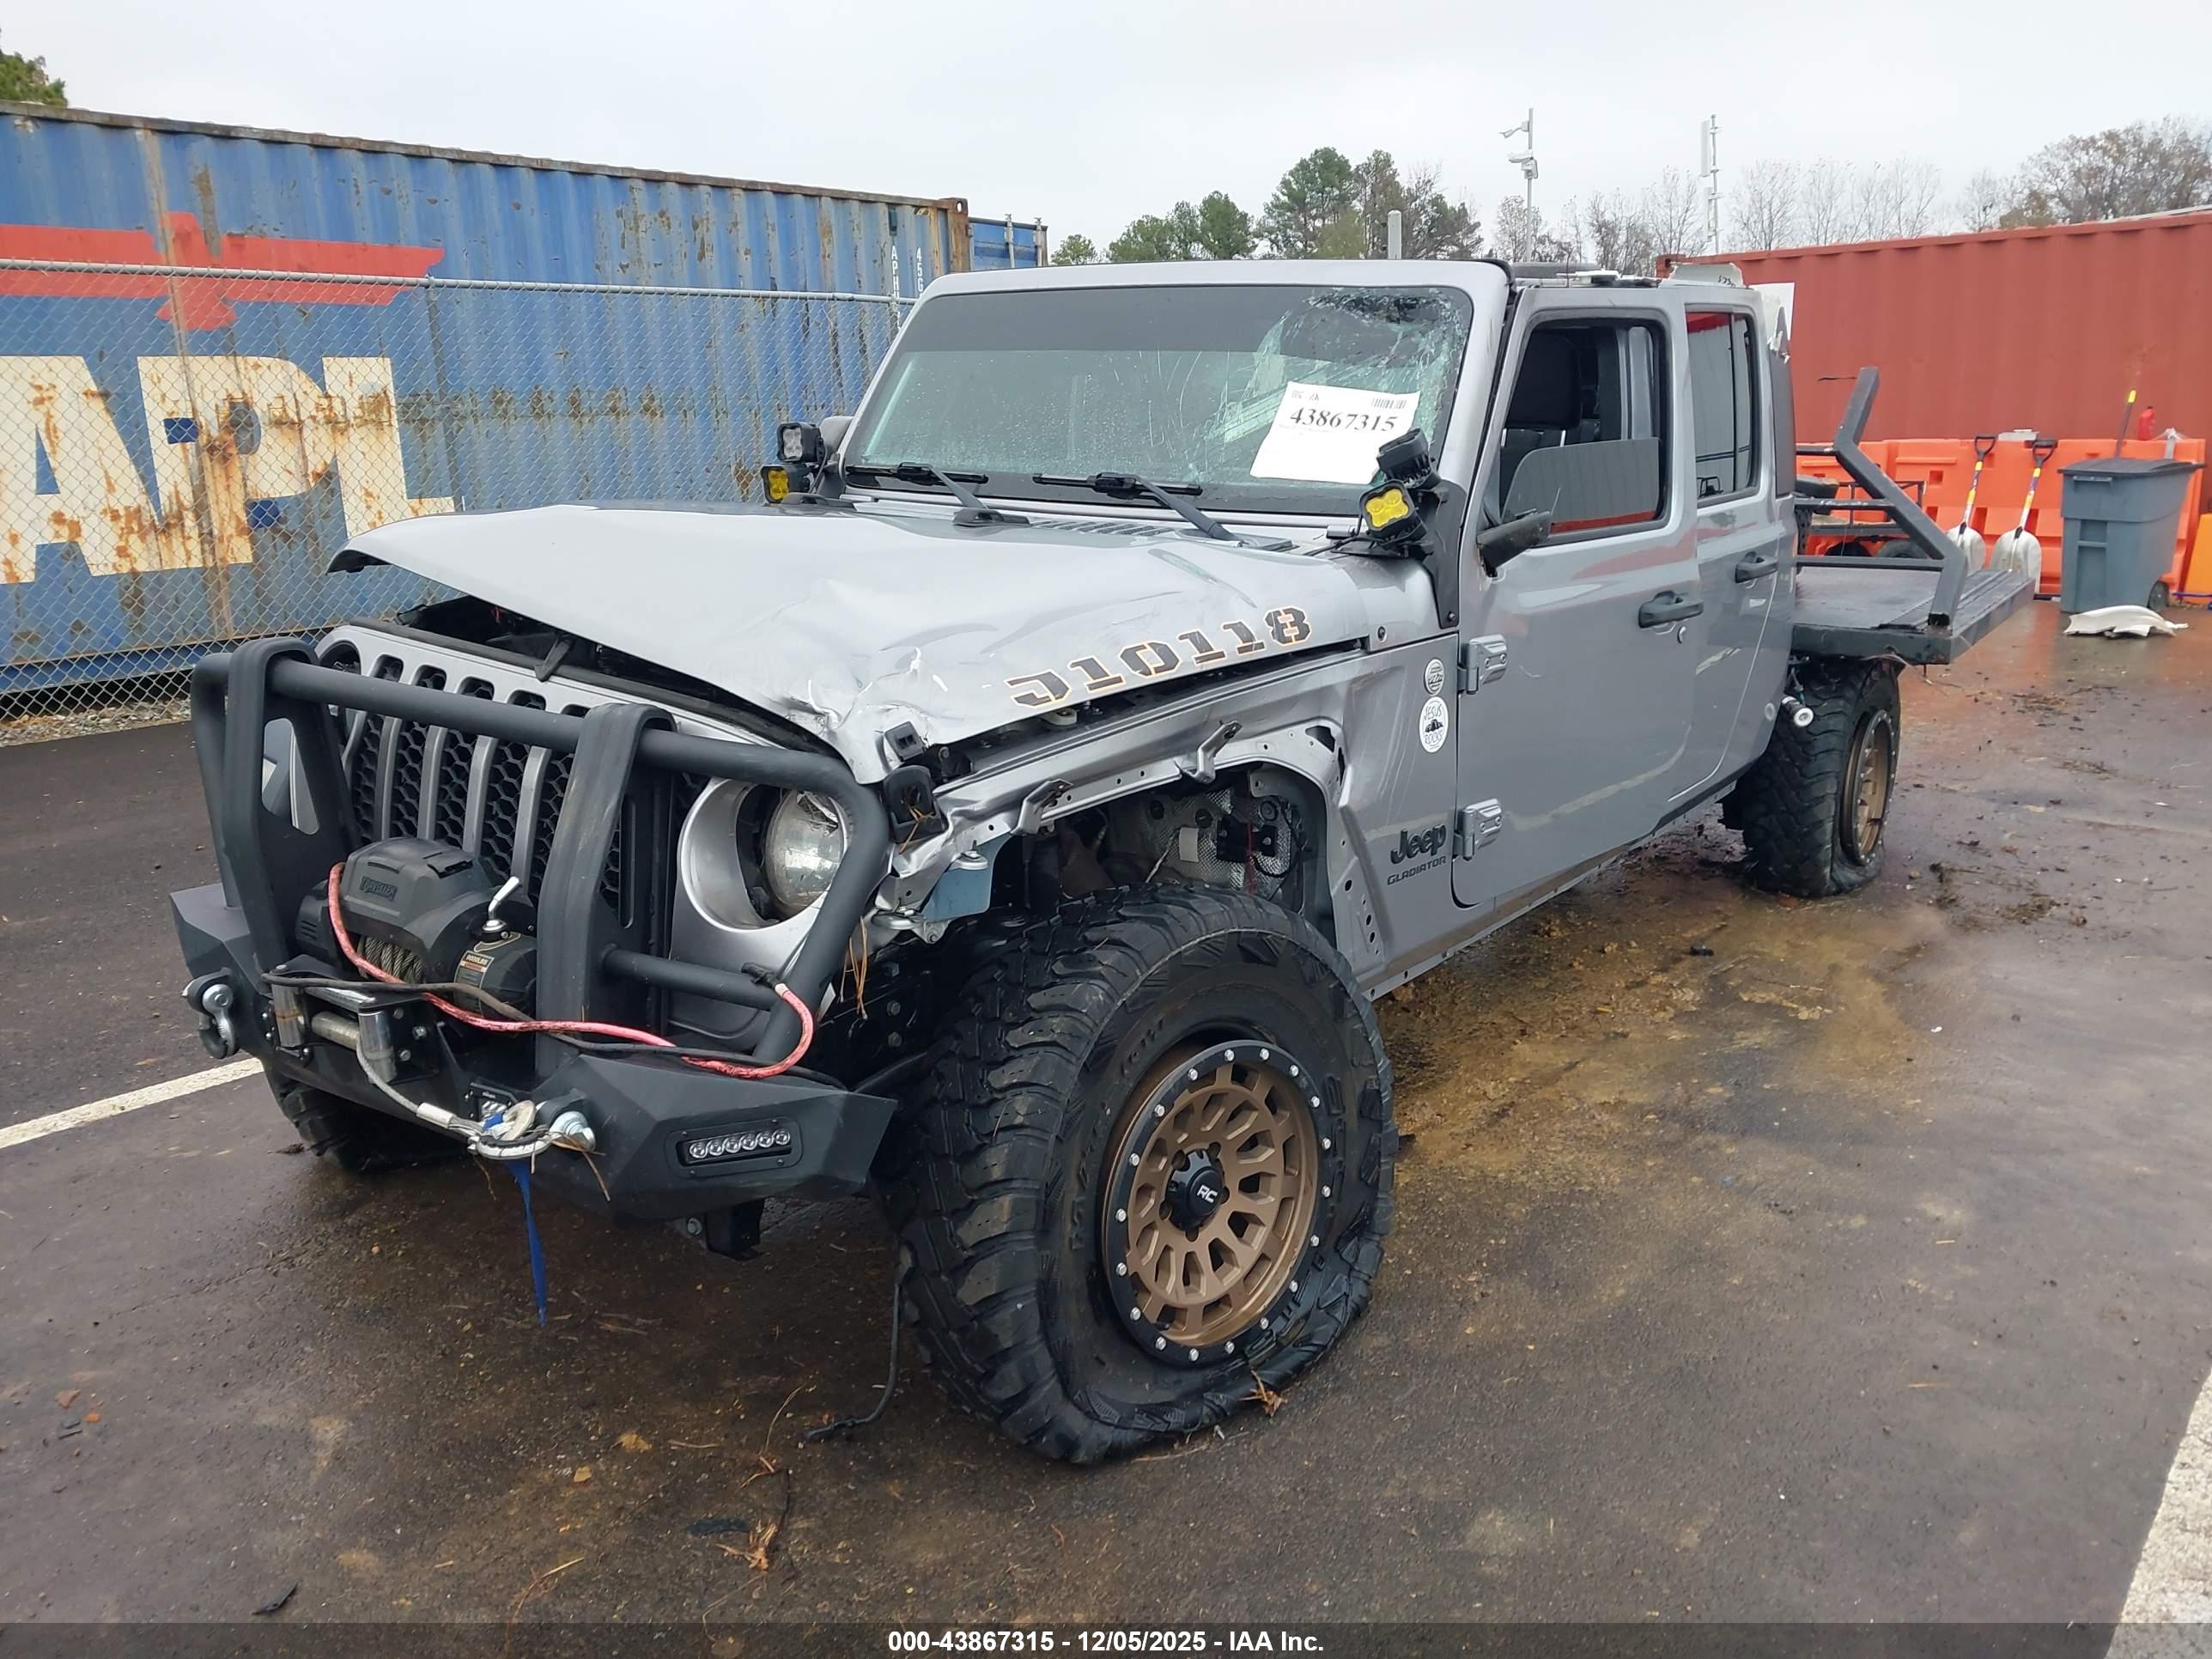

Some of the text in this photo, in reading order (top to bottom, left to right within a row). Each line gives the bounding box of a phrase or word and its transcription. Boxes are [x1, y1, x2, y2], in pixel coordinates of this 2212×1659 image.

[1290, 407, 1398, 432] 43867315
[0, 355, 454, 583] APL
[1003, 605, 1313, 708] J10118
[1390, 824, 1446, 865] Jeep
[1387, 855, 1446, 885] GLADIATOR
[1196, 1184, 1218, 1203] RC
